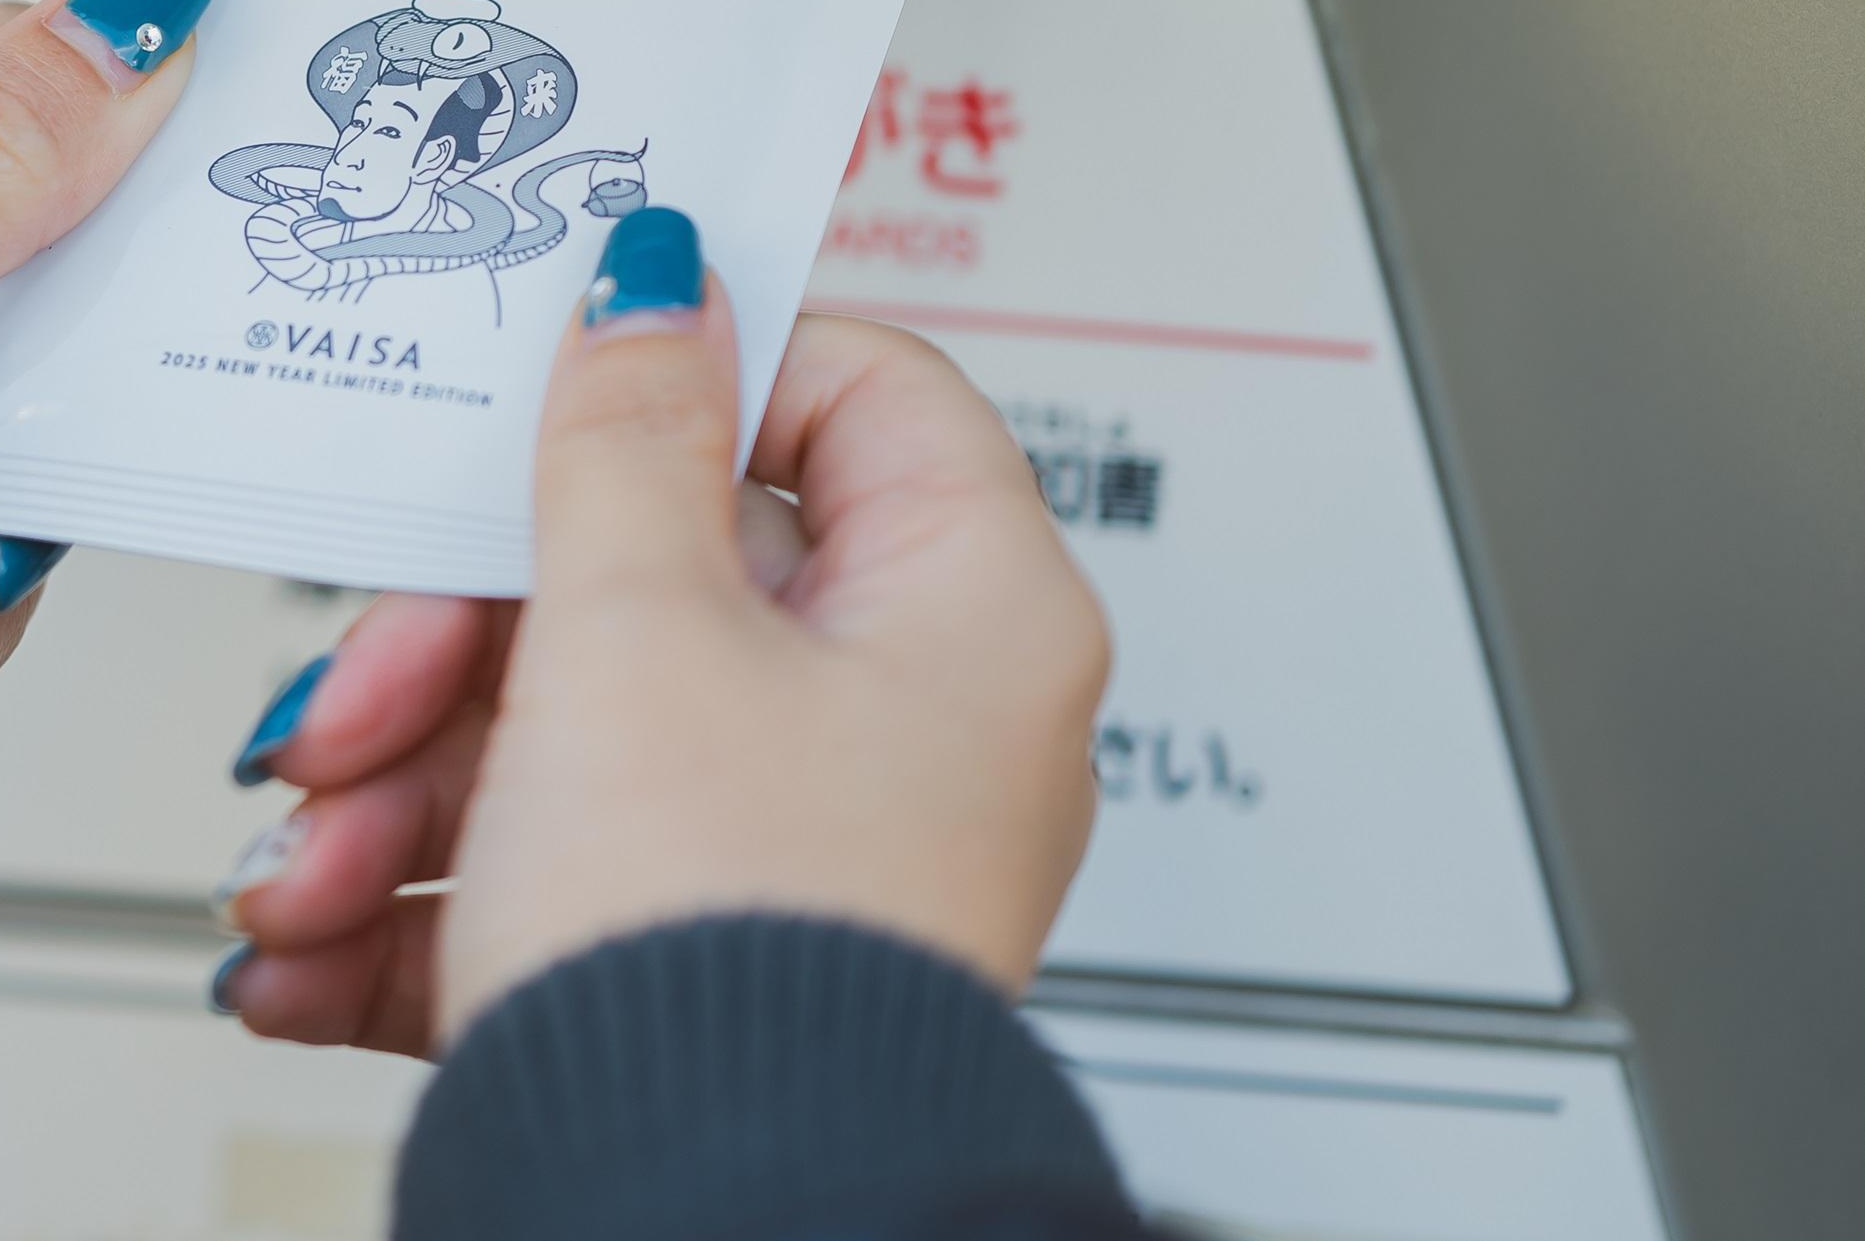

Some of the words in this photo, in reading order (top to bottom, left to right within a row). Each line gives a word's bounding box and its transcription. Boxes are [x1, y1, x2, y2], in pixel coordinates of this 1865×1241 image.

[320, 45, 368, 95] 福
[287, 323, 424, 371] VAISA
[159, 350, 208, 371] 2025
[214, 356, 261, 377] NEW
[267, 364, 316, 384] YEAR
[322, 372, 405, 398] LIMITED
[410, 383, 495, 408] EDITION
